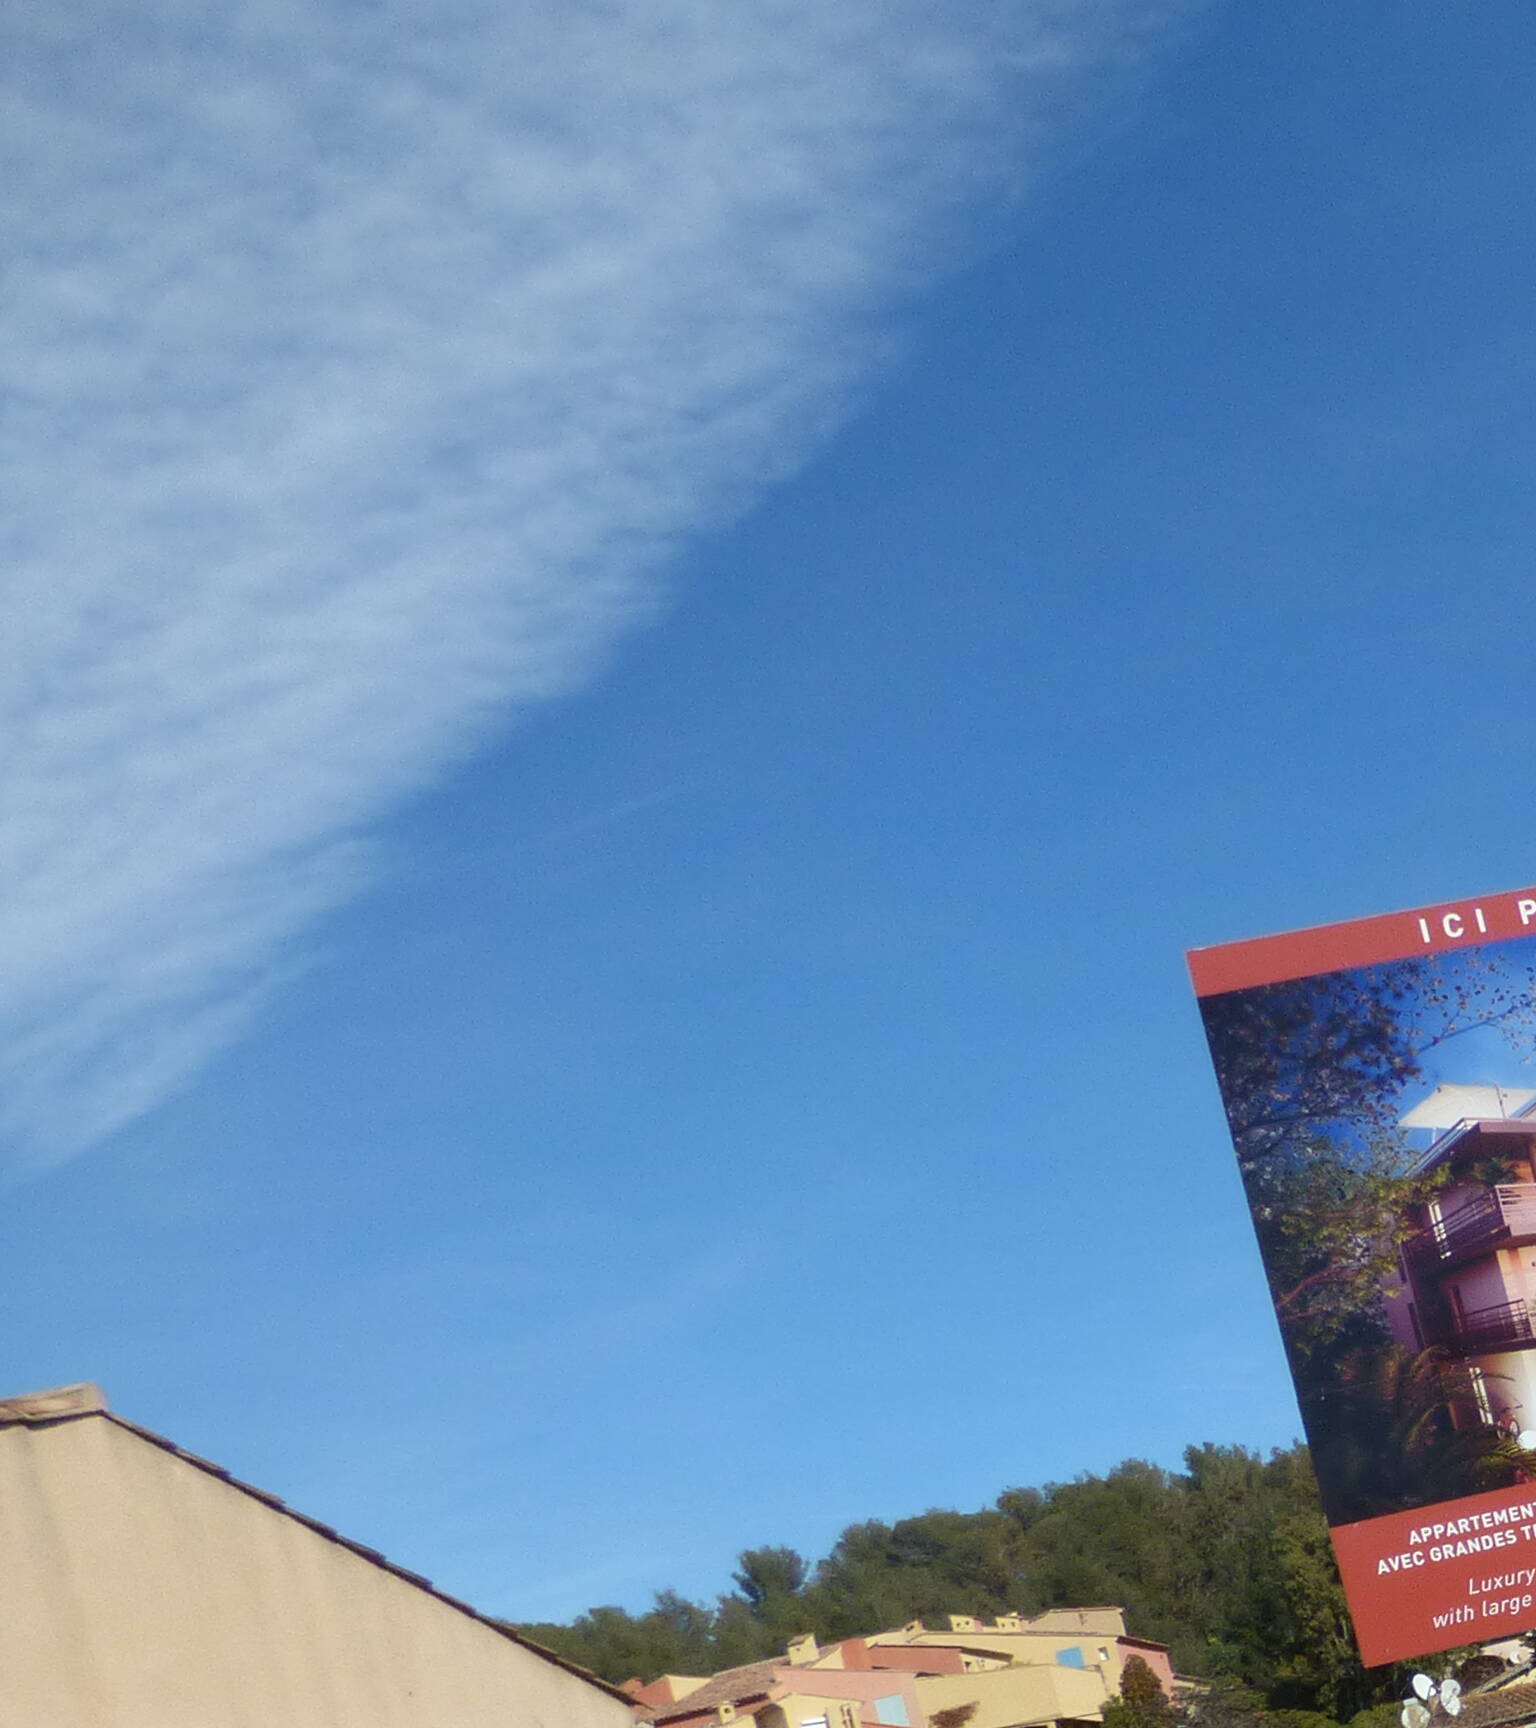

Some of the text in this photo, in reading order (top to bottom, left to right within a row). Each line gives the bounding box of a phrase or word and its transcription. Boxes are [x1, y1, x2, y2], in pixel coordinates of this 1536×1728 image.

[1418, 908, 1488, 944] ICI
[1376, 1549, 1425, 1576] AVEC
[1429, 1527, 1518, 1563] GRANDES
[1468, 1565, 1536, 1596] Luxury
[1432, 1603, 1476, 1630] with
[1481, 1590, 1533, 1618] large
